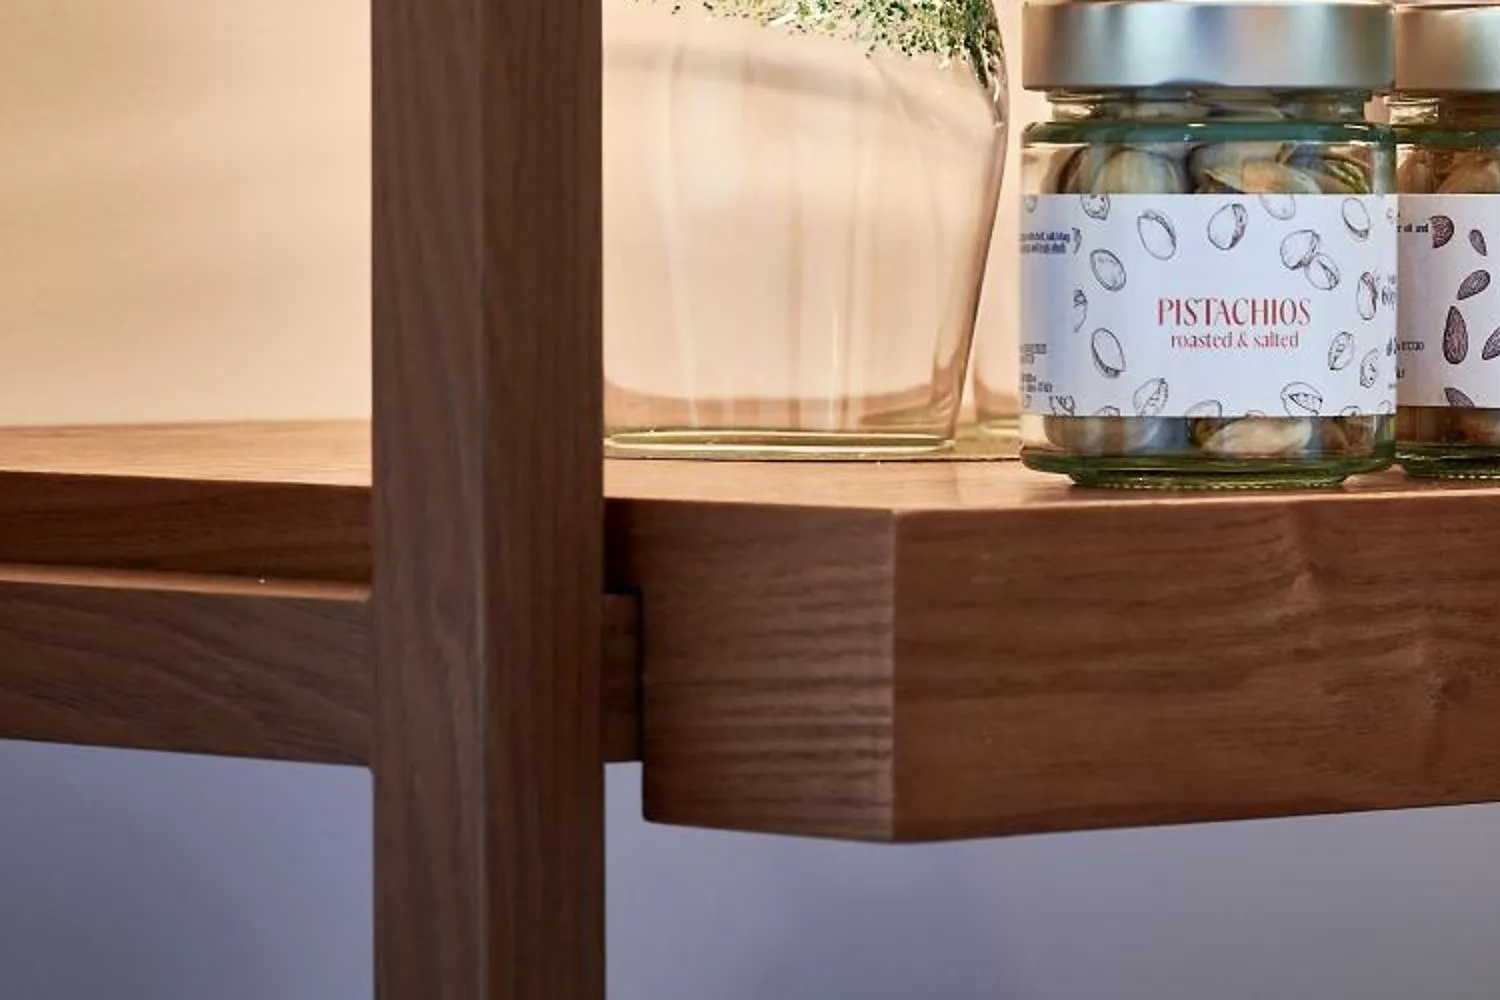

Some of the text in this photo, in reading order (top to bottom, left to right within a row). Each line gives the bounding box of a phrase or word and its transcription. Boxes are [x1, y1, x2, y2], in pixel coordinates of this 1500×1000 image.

[1158, 298, 1311, 326] PISTACHIOS
[1171, 331, 1300, 349] roasted & salted
